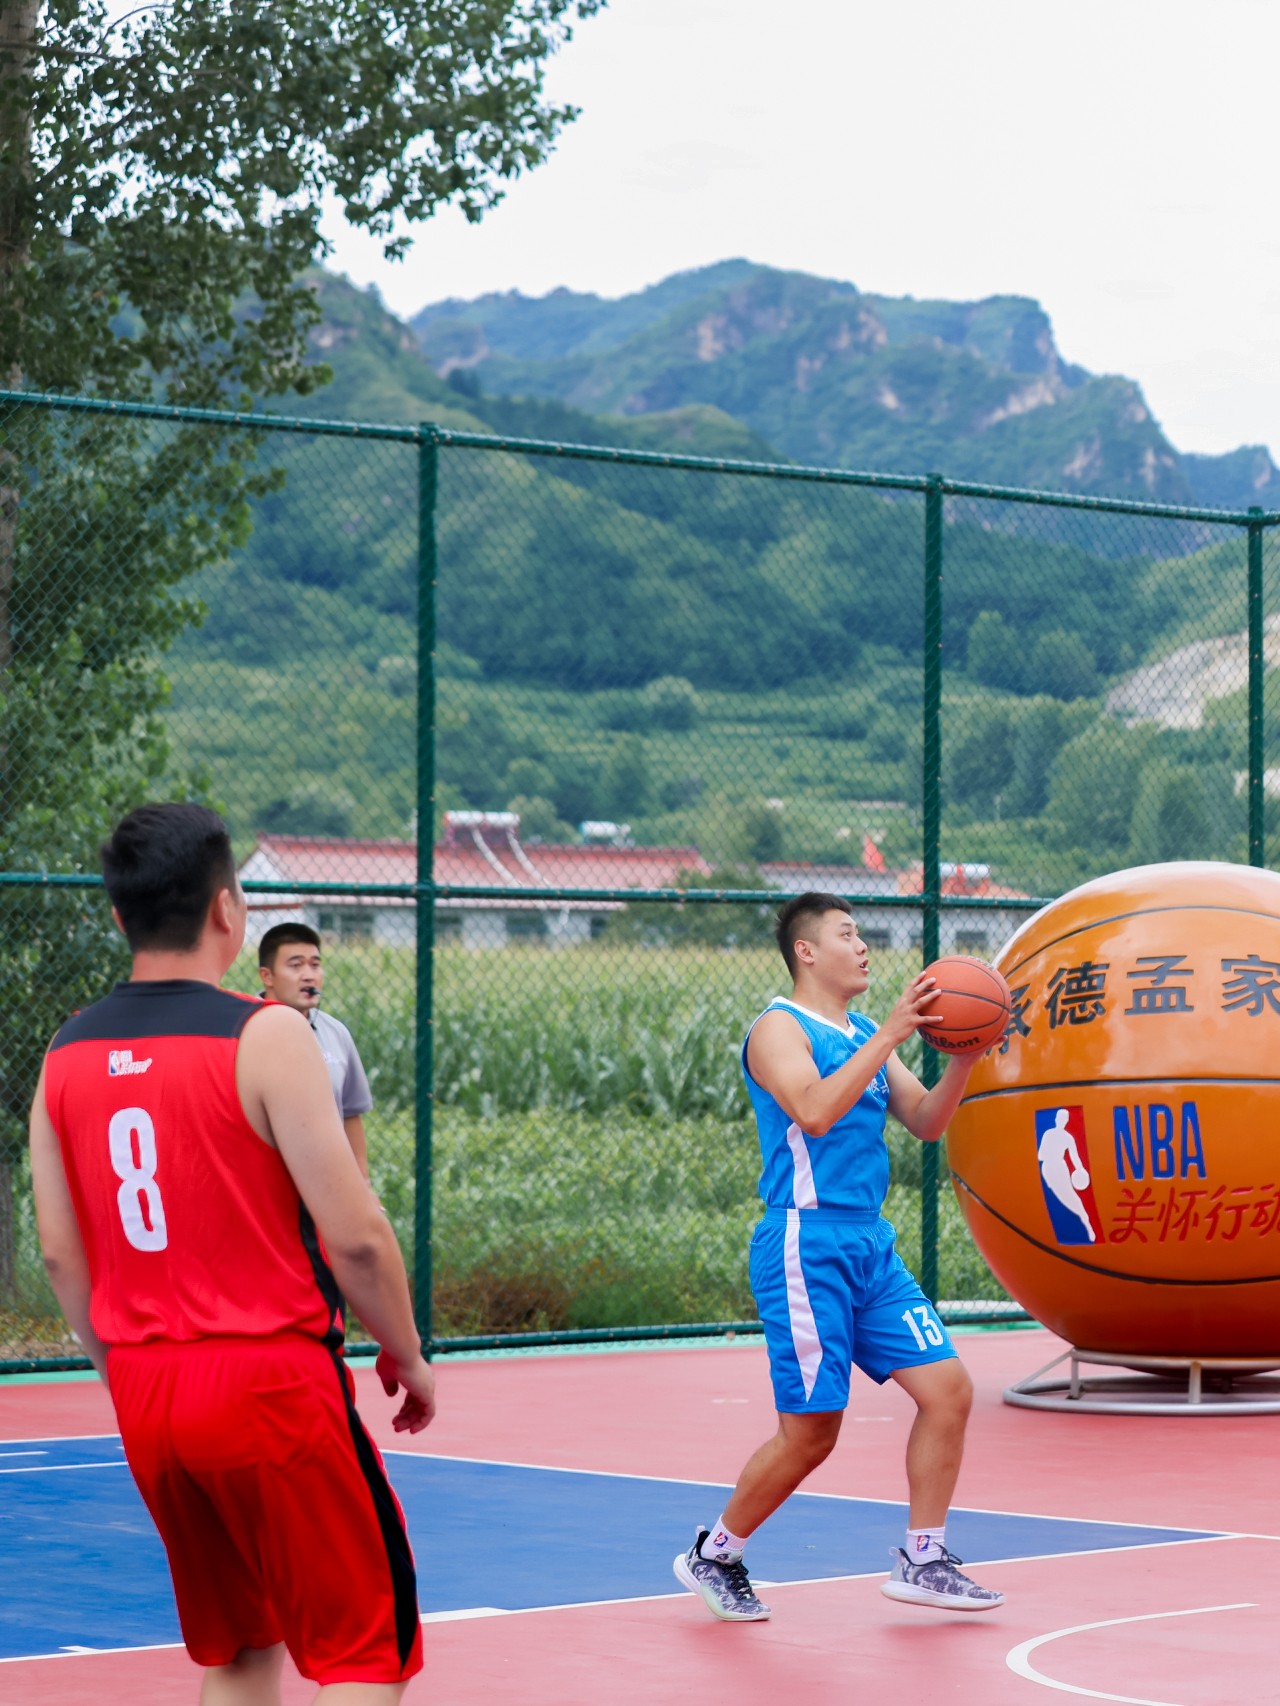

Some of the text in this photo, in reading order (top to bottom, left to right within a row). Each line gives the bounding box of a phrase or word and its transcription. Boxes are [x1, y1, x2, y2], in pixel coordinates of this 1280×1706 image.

[108, 1107, 168, 1252] 8
[1112, 1101, 1207, 1181] NBA
[901, 1306, 944, 1351] 13
